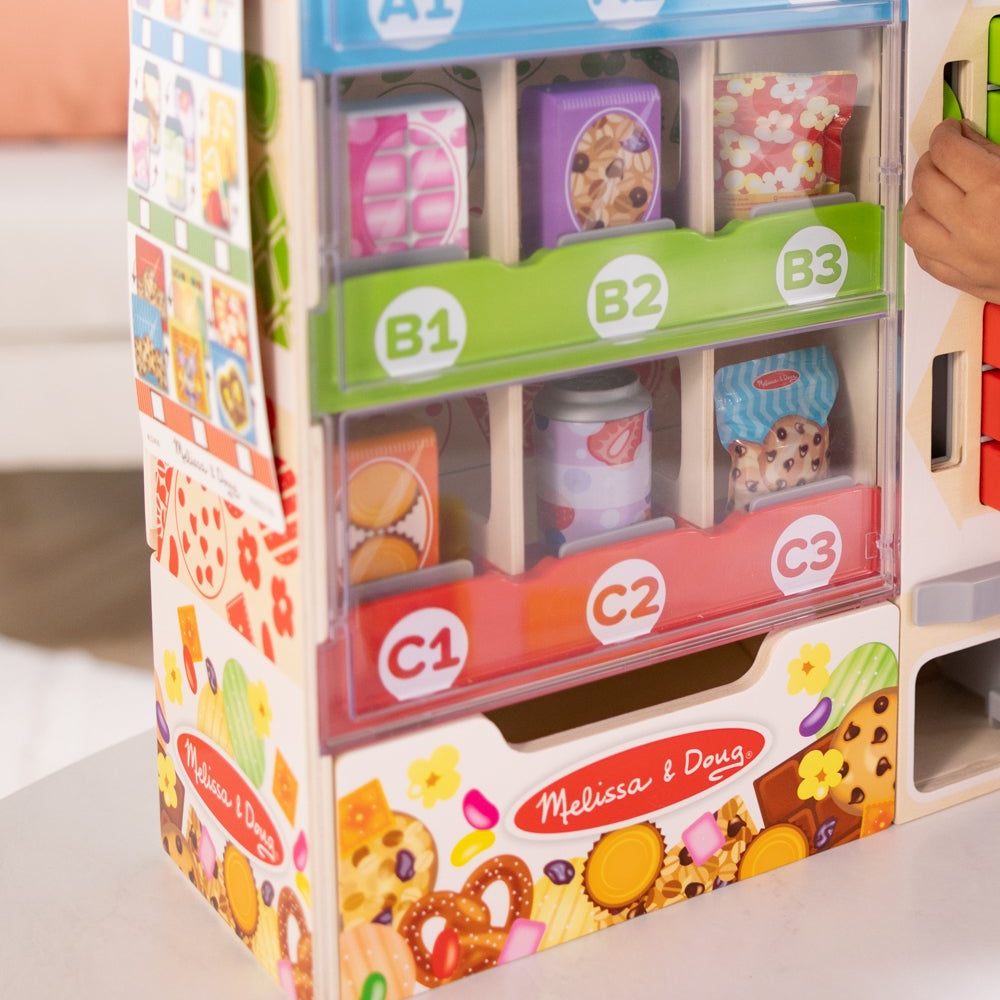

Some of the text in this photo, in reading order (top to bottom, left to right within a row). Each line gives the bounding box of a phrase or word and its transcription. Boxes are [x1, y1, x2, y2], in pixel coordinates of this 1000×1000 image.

[783, 243, 843, 292] B3
[595, 273, 663, 323] B2
[385, 307, 459, 360] B1
[776, 530, 837, 579] C3
[592, 575, 660, 627] C2
[387, 626, 460, 680] C1
[184, 737, 233, 808] Melissa
[535, 776, 653, 826] Melissa
[662, 758, 676, 783] &
